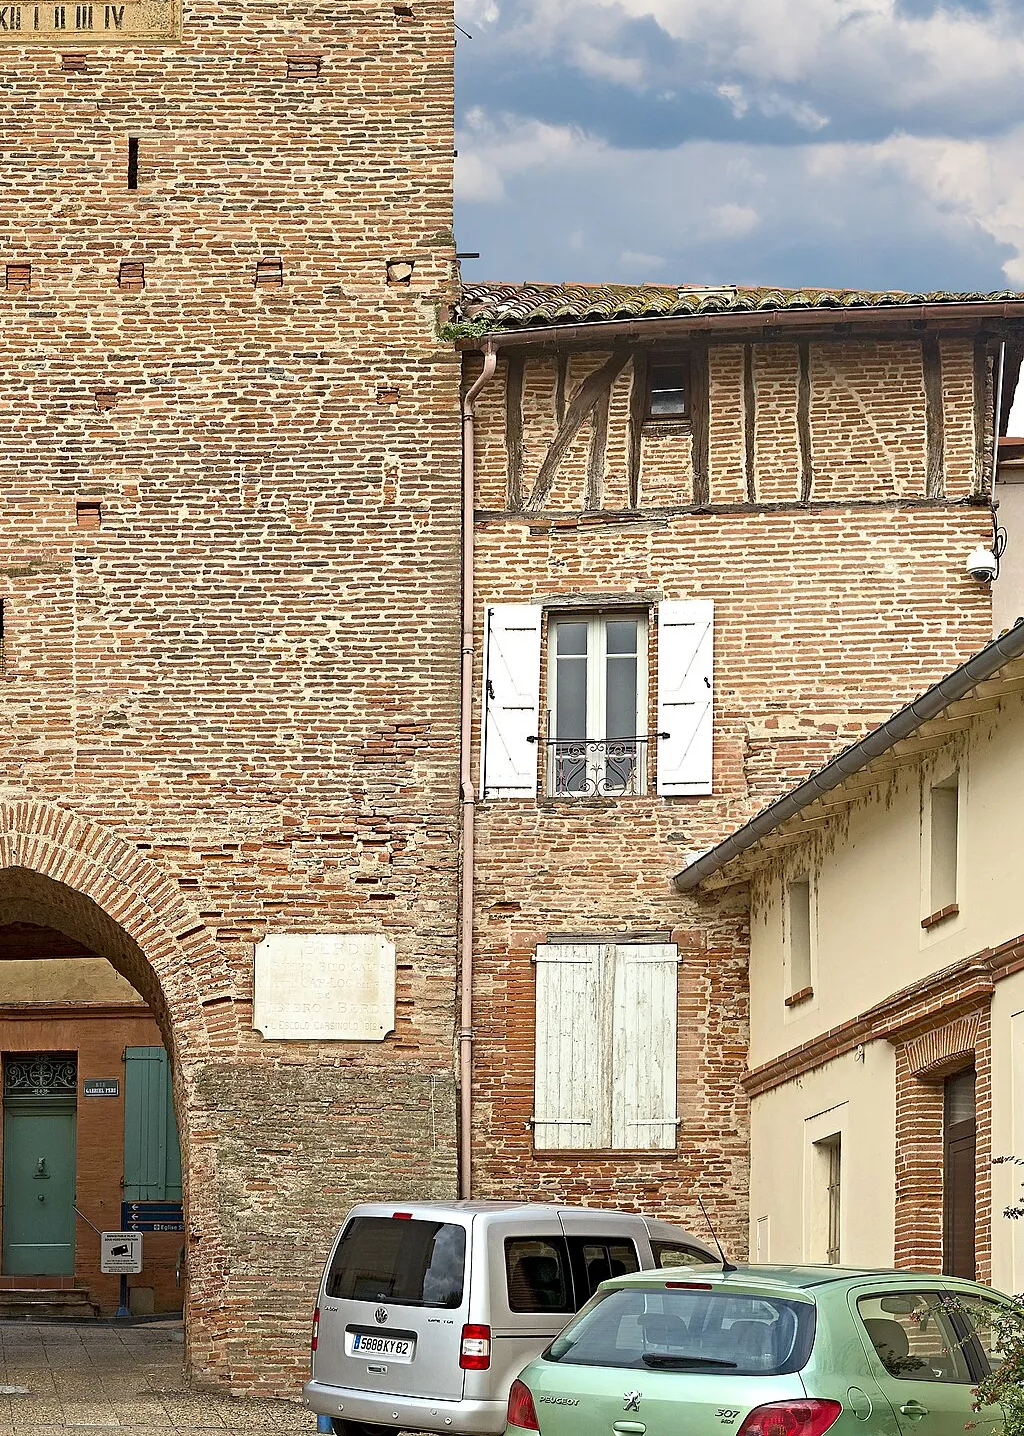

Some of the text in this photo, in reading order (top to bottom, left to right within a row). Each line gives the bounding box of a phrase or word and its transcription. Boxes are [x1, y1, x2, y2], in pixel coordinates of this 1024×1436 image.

[33, 6, 40, 31] I
[54, 6, 66, 30] II
[76, 5, 94, 31] III
[104, 5, 125, 31] IV
[539, 1395, 580, 1407] PEUGEOT
[715, 1408, 741, 1419] 307
